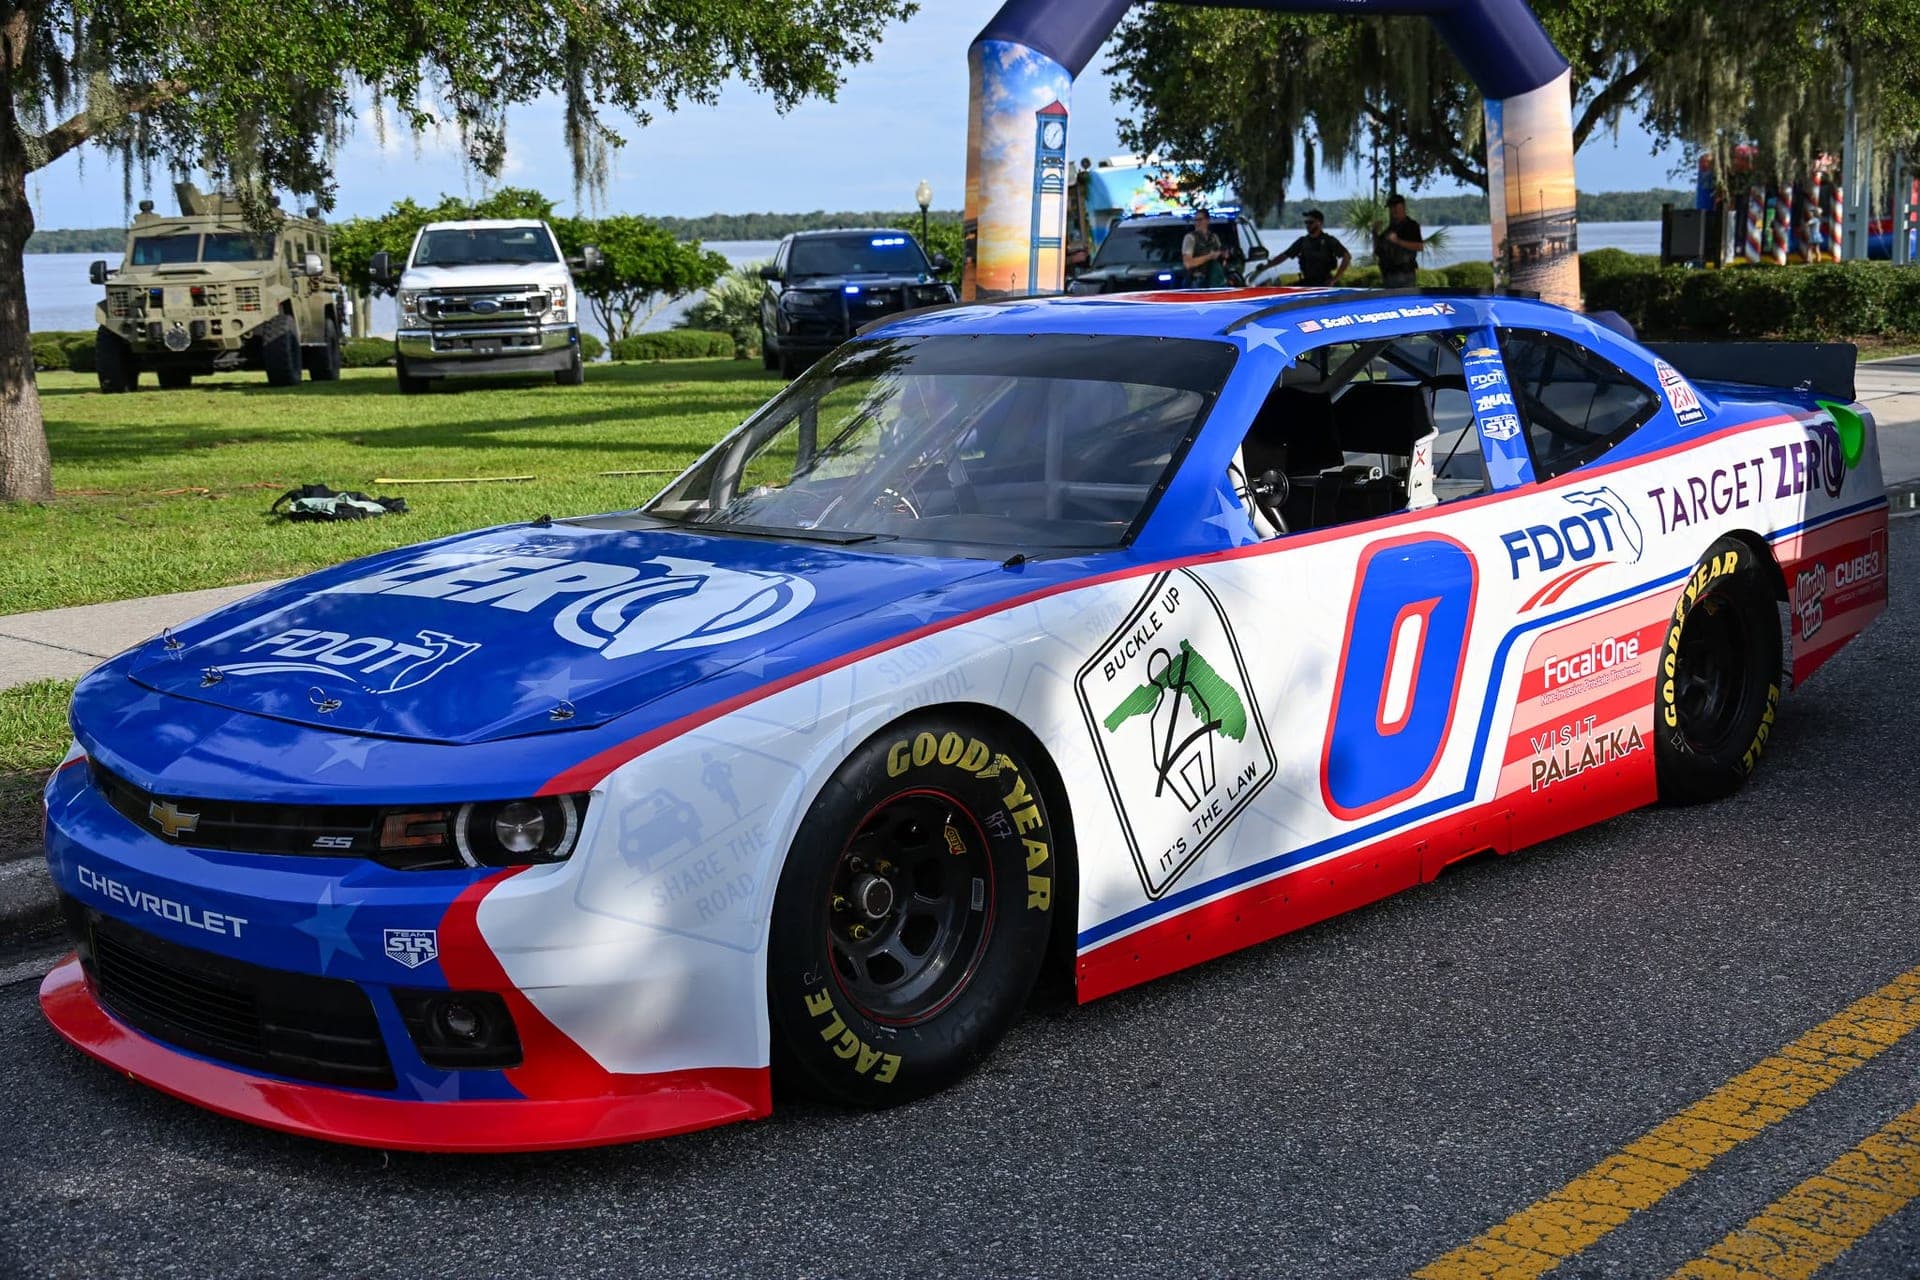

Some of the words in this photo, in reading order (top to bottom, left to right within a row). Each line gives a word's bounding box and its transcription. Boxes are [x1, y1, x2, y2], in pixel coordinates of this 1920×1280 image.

[1320, 315, 1354, 329] Scott
[1470, 373, 1503, 385] FDOT
[1647, 457, 1765, 535] TARGET
[1499, 506, 1614, 580] FDOT
[1835, 551, 1879, 588] CUBE3
[240, 628, 434, 674] FDOT
[1103, 611, 1164, 683] BUCKLE
[1161, 586, 1181, 615] UP
[1662, 551, 1739, 728] GOODYEAR
[1320, 531, 1480, 821] 0
[1531, 715, 1596, 756] VISIT
[1531, 724, 1645, 792] PALATKA
[1743, 684, 1779, 774] EAGLE
[312, 836, 354, 849] SS
[886, 731, 1051, 912] GOODYEAR
[1159, 837, 1187, 872] IT'S
[1191, 799, 1223, 836] THE
[1227, 762, 1258, 801] LAW
[78, 865, 248, 938] CHEVROLET
[652, 858, 726, 908] SHARE
[728, 823, 772, 862] THE
[696, 871, 756, 921] ROAD
[389, 937, 434, 952] SLR
[803, 987, 902, 1084] EAGLE
